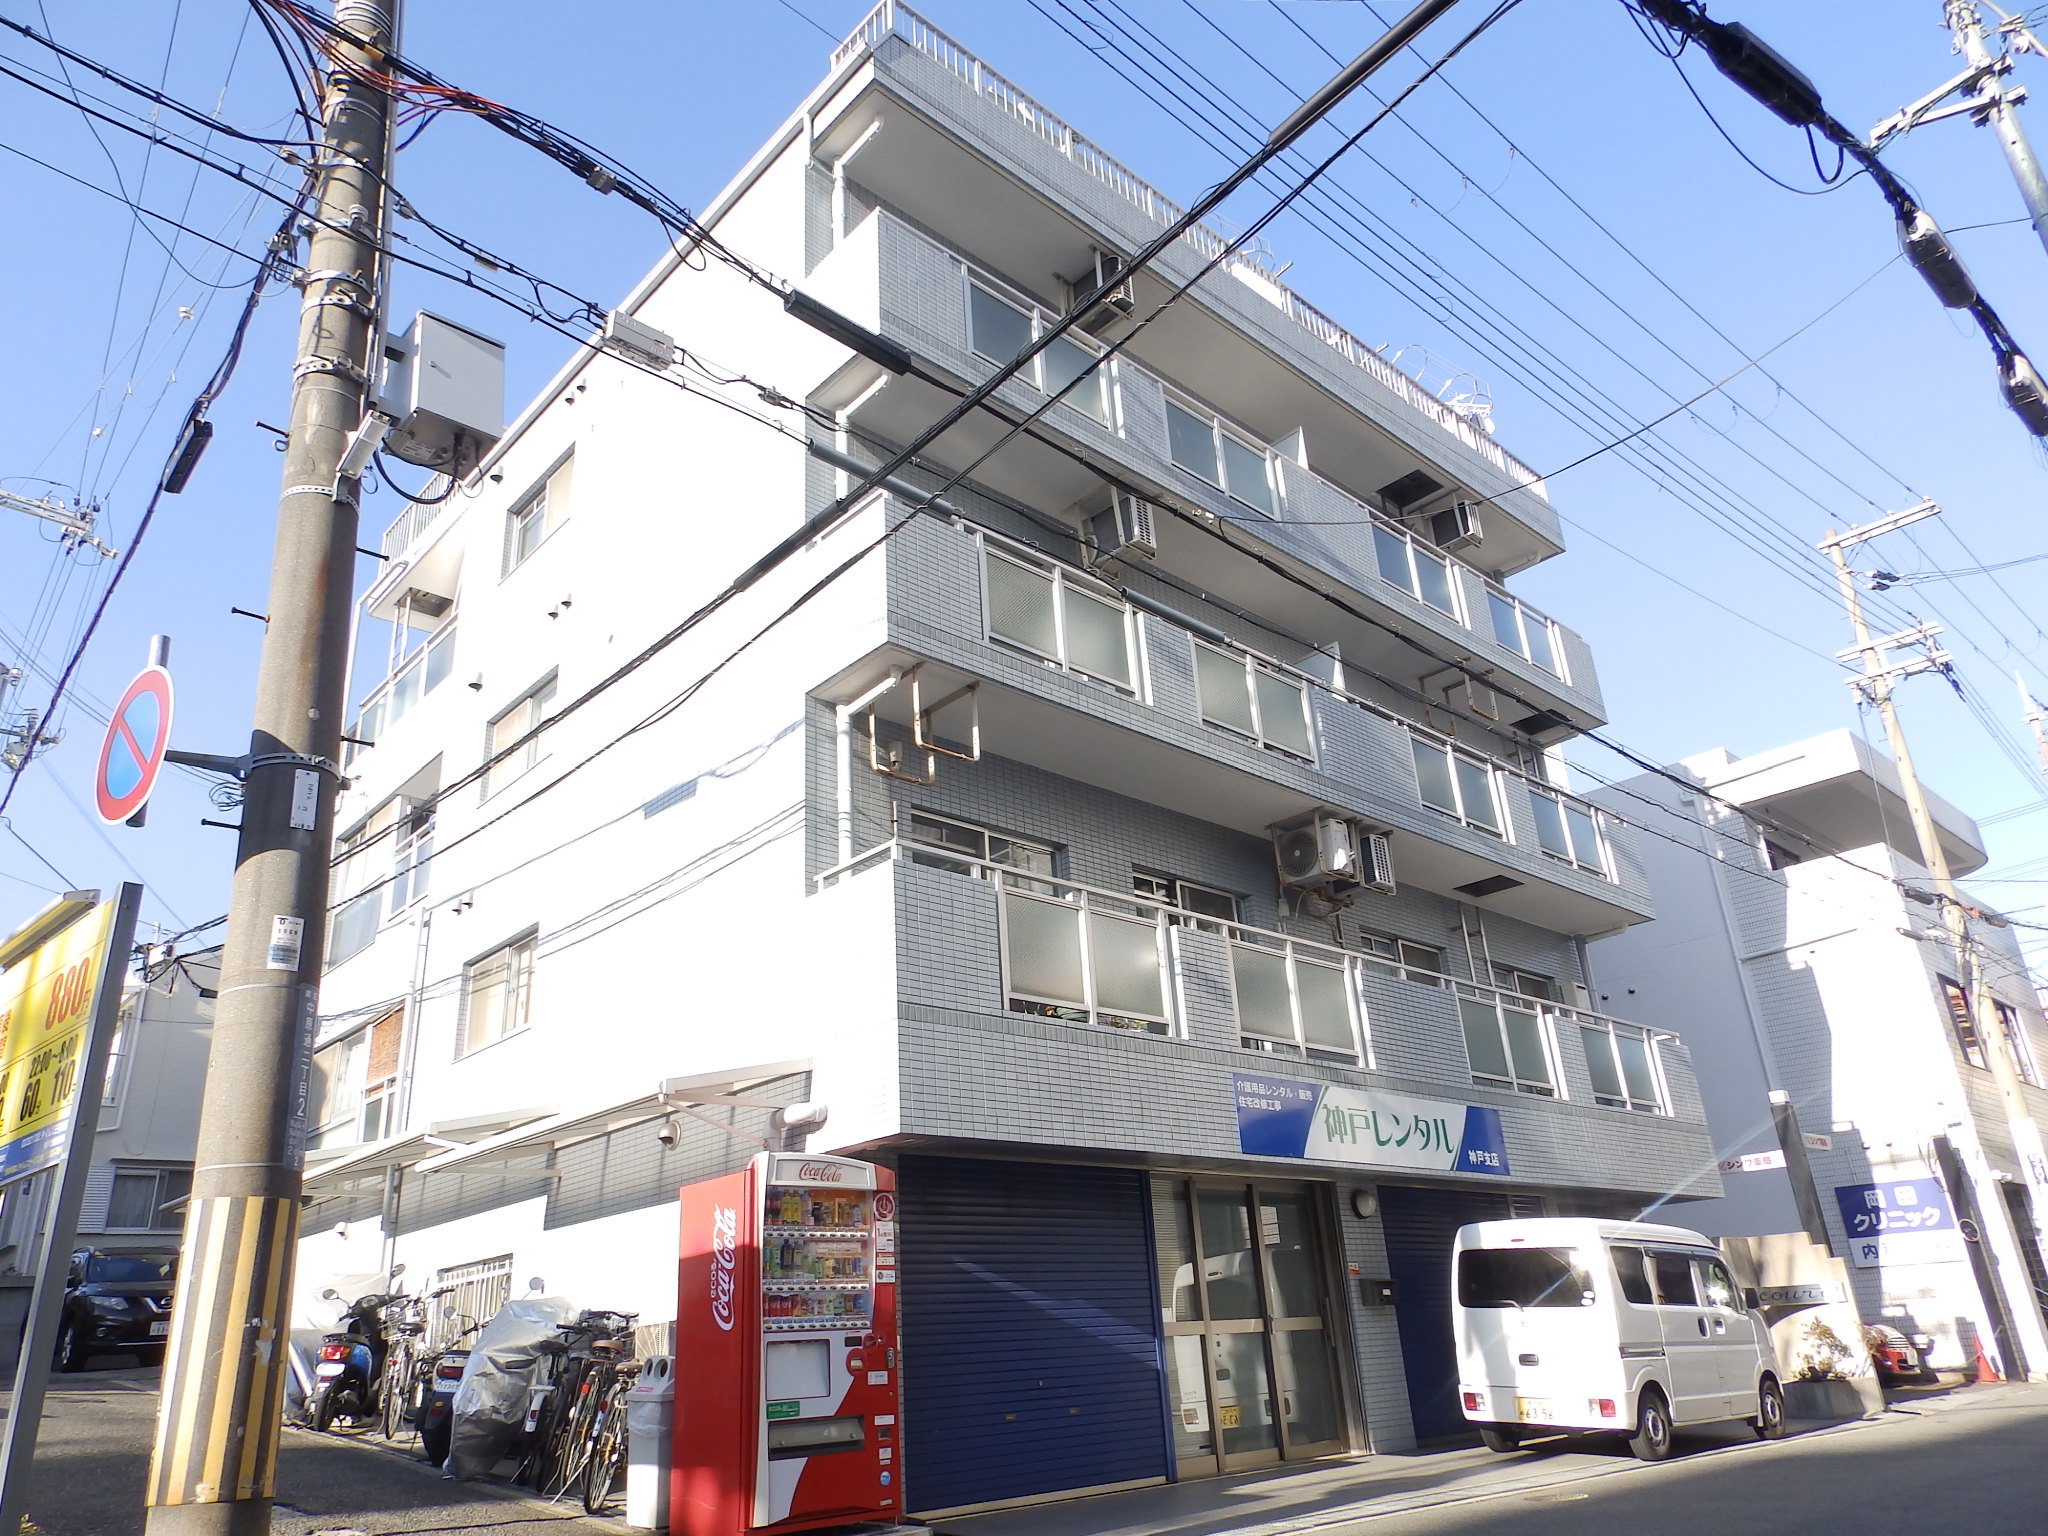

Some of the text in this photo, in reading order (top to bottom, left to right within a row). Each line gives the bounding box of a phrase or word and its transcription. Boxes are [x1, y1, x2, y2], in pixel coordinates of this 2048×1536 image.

[1321, 1103, 1455, 1154] 神戸レンタル
[1467, 1150, 1500, 1167] 神戸支店
[1854, 1206, 1941, 1232] クリニック
